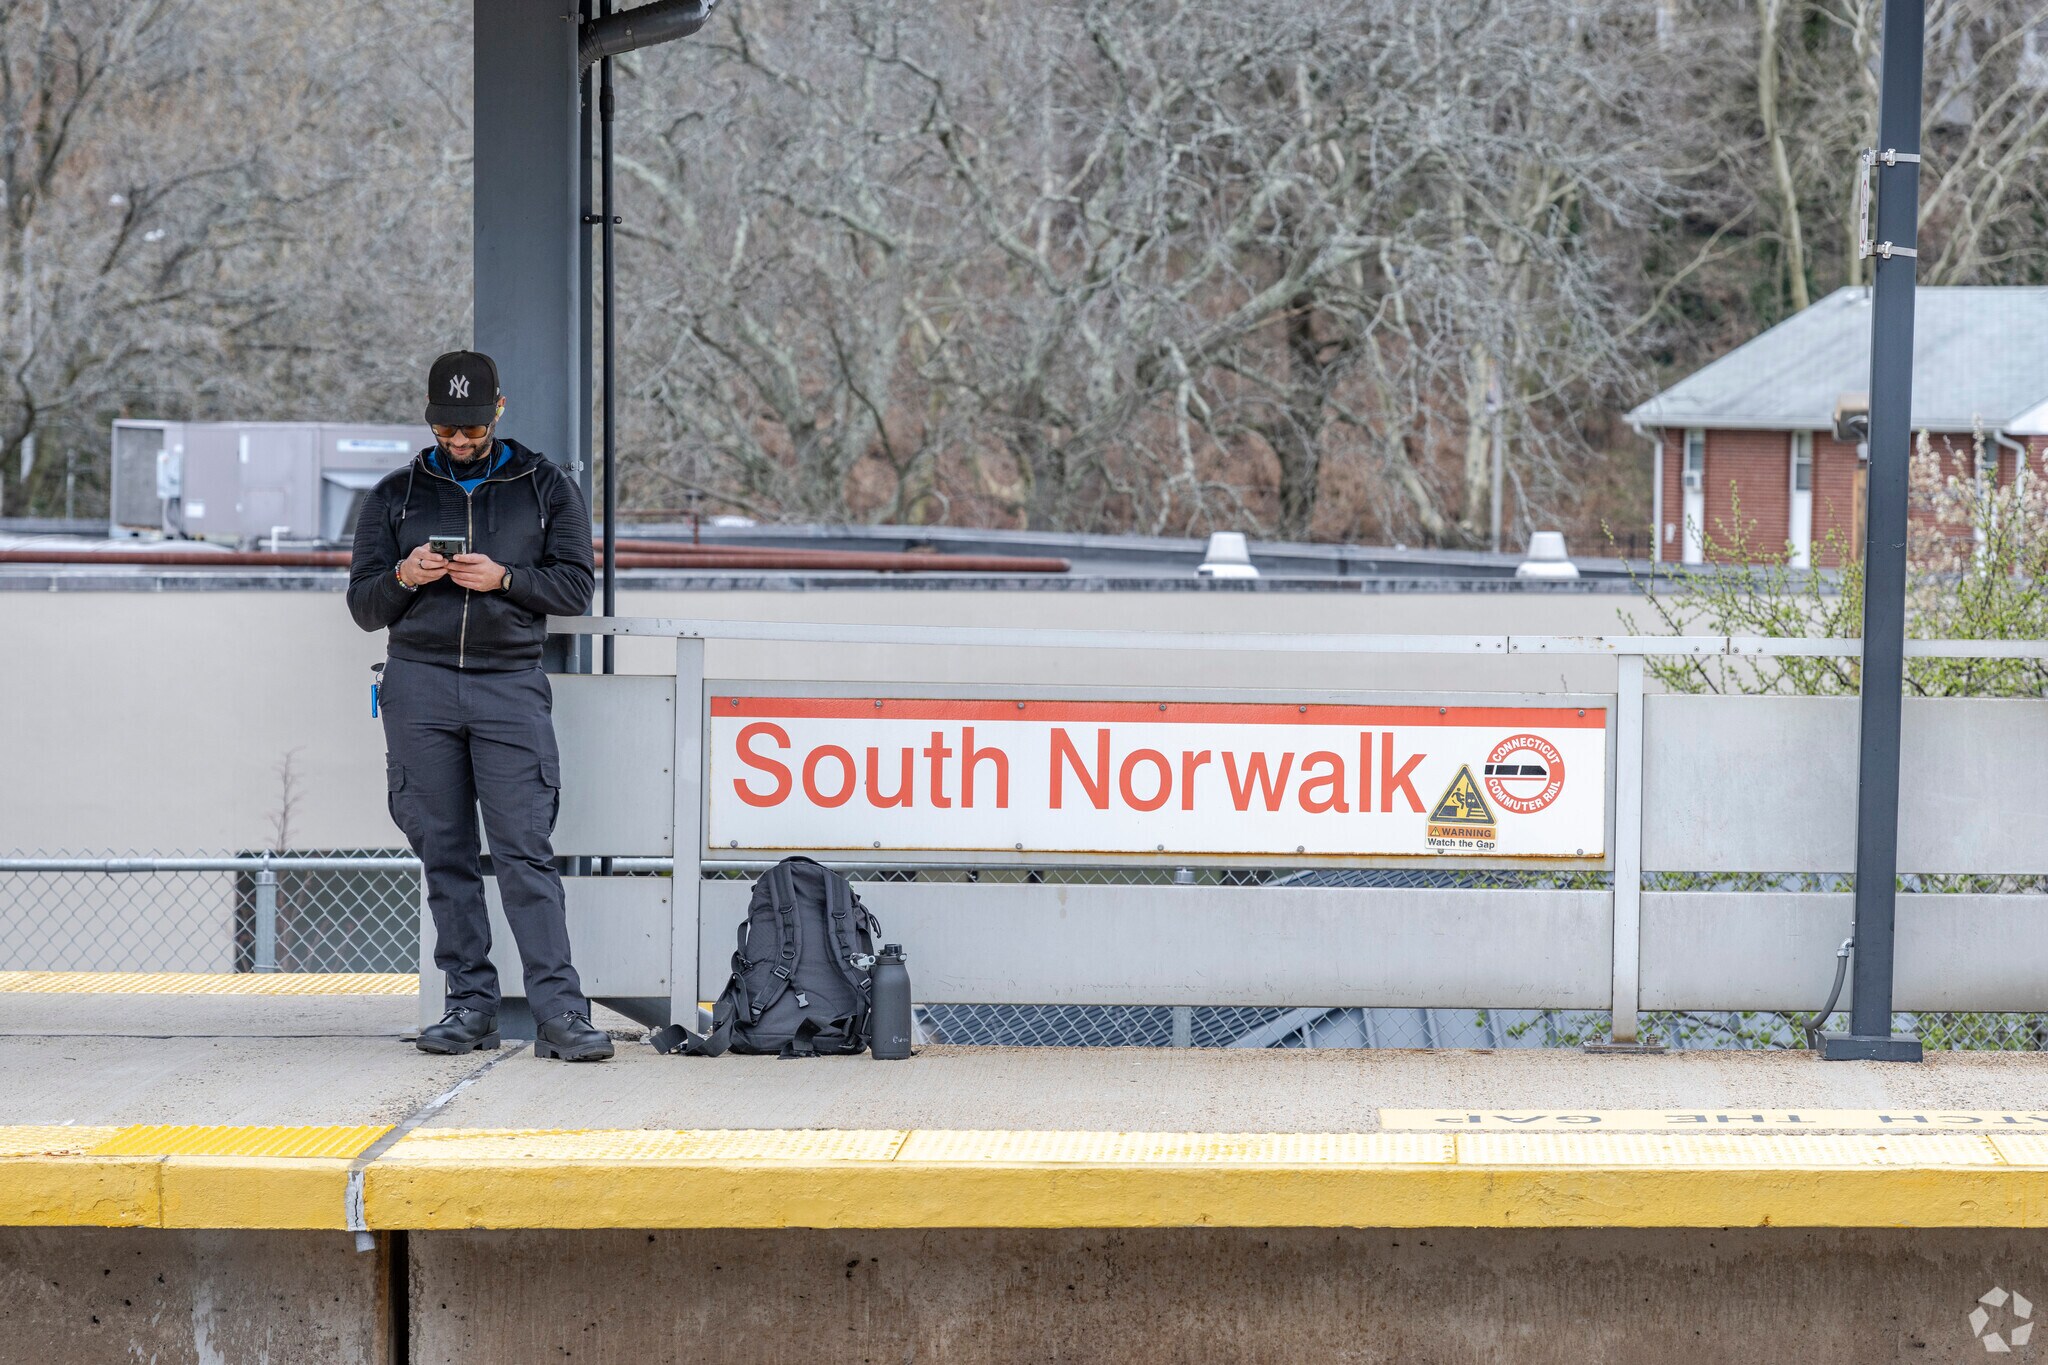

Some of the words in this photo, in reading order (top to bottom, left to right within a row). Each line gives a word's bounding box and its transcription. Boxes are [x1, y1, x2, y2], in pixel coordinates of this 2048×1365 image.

[448, 374, 470, 398] NY
[1492, 737, 1560, 764] CONNECTICUT
[733, 716, 1009, 808] South
[1049, 727, 1427, 814] Norwalk
[1489, 779, 1544, 811] COMMUTER
[1542, 780, 1561, 802] RAIL
[1442, 827, 1492, 838] WARNING
[1427, 838, 1456, 847] Watch
[1459, 839, 1473, 848] the
[1476, 840, 1495, 850] Gap
[1435, 1113, 1602, 1124] GAP
[1665, 1114, 1816, 1124] THE
